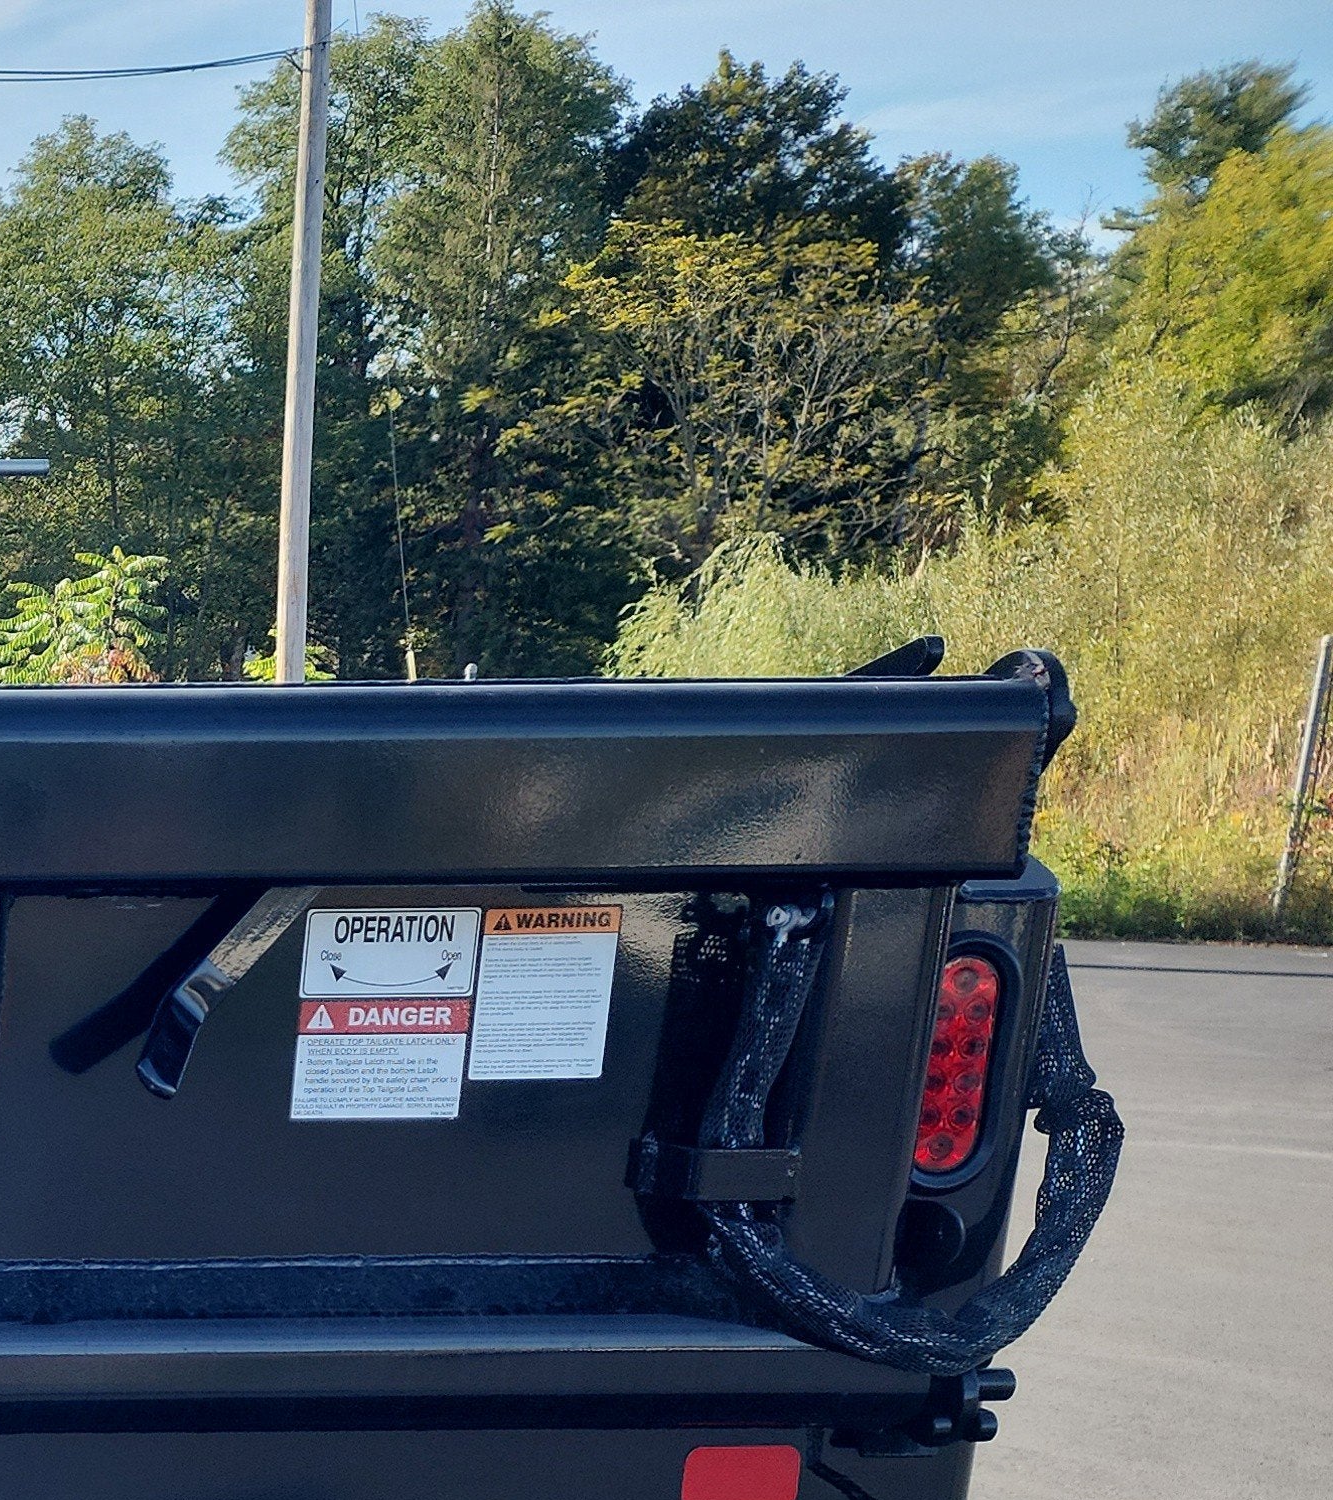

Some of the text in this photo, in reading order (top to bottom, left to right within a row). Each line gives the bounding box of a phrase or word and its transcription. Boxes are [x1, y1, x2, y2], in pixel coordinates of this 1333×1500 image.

[517, 912, 611, 928] WARNING
[335, 914, 455, 944] OPERATION
[321, 950, 342, 961] Close
[442, 950, 462, 961] Open
[348, 1007, 452, 1026] DANGER
[307, 1038, 344, 1046] OPERATE
[348, 1038, 363, 1046] TOP
[367, 1038, 404, 1046] TAILGATE
